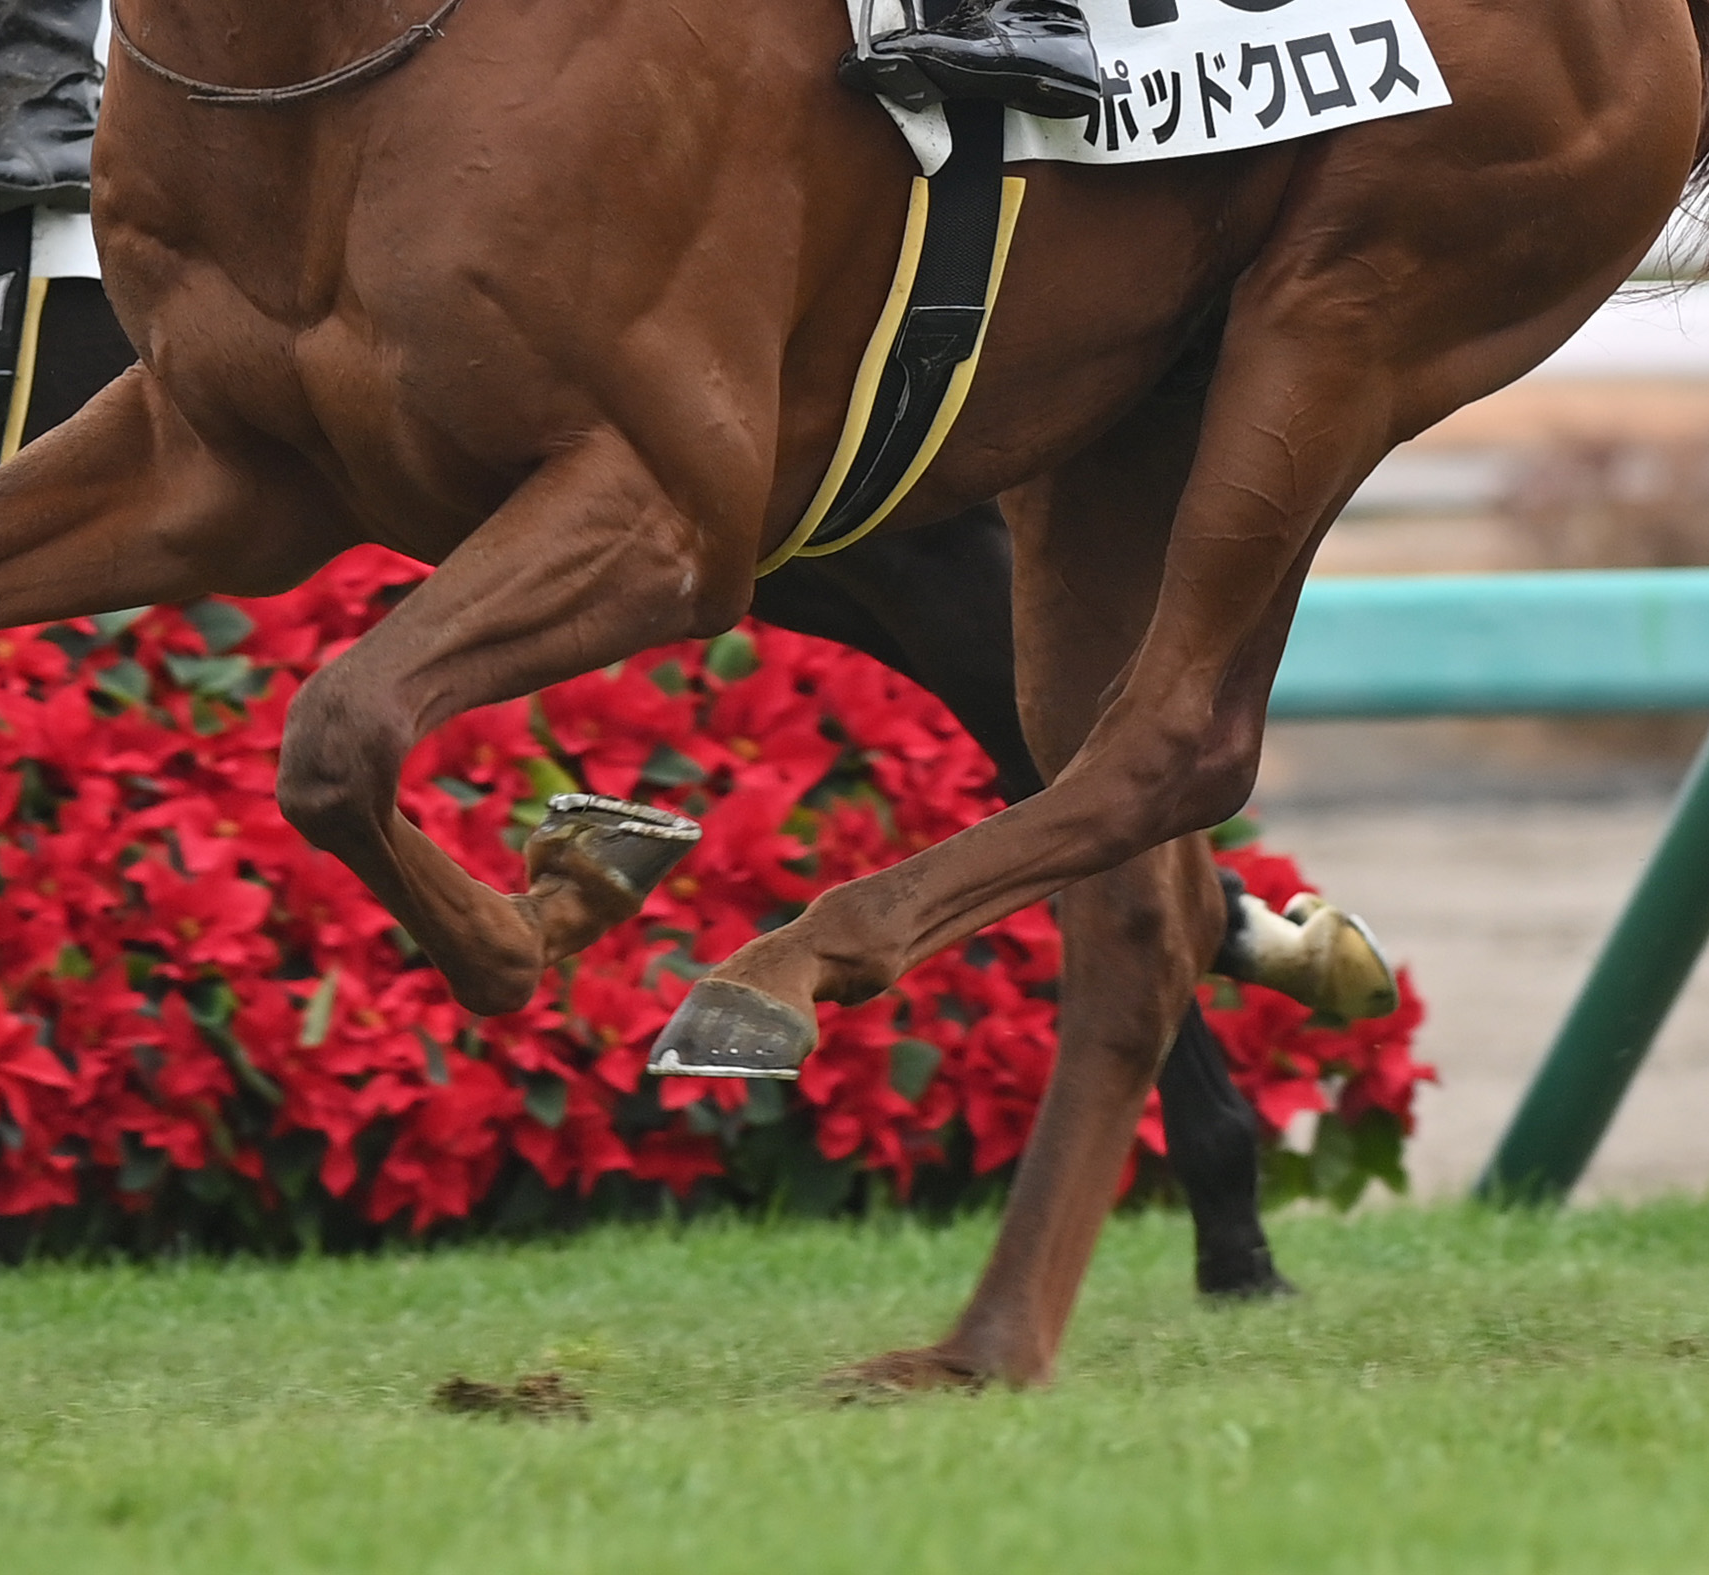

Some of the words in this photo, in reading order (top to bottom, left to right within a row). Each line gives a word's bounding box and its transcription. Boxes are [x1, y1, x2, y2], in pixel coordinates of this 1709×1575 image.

[1083, 19, 1420, 152] ポッドクロス
